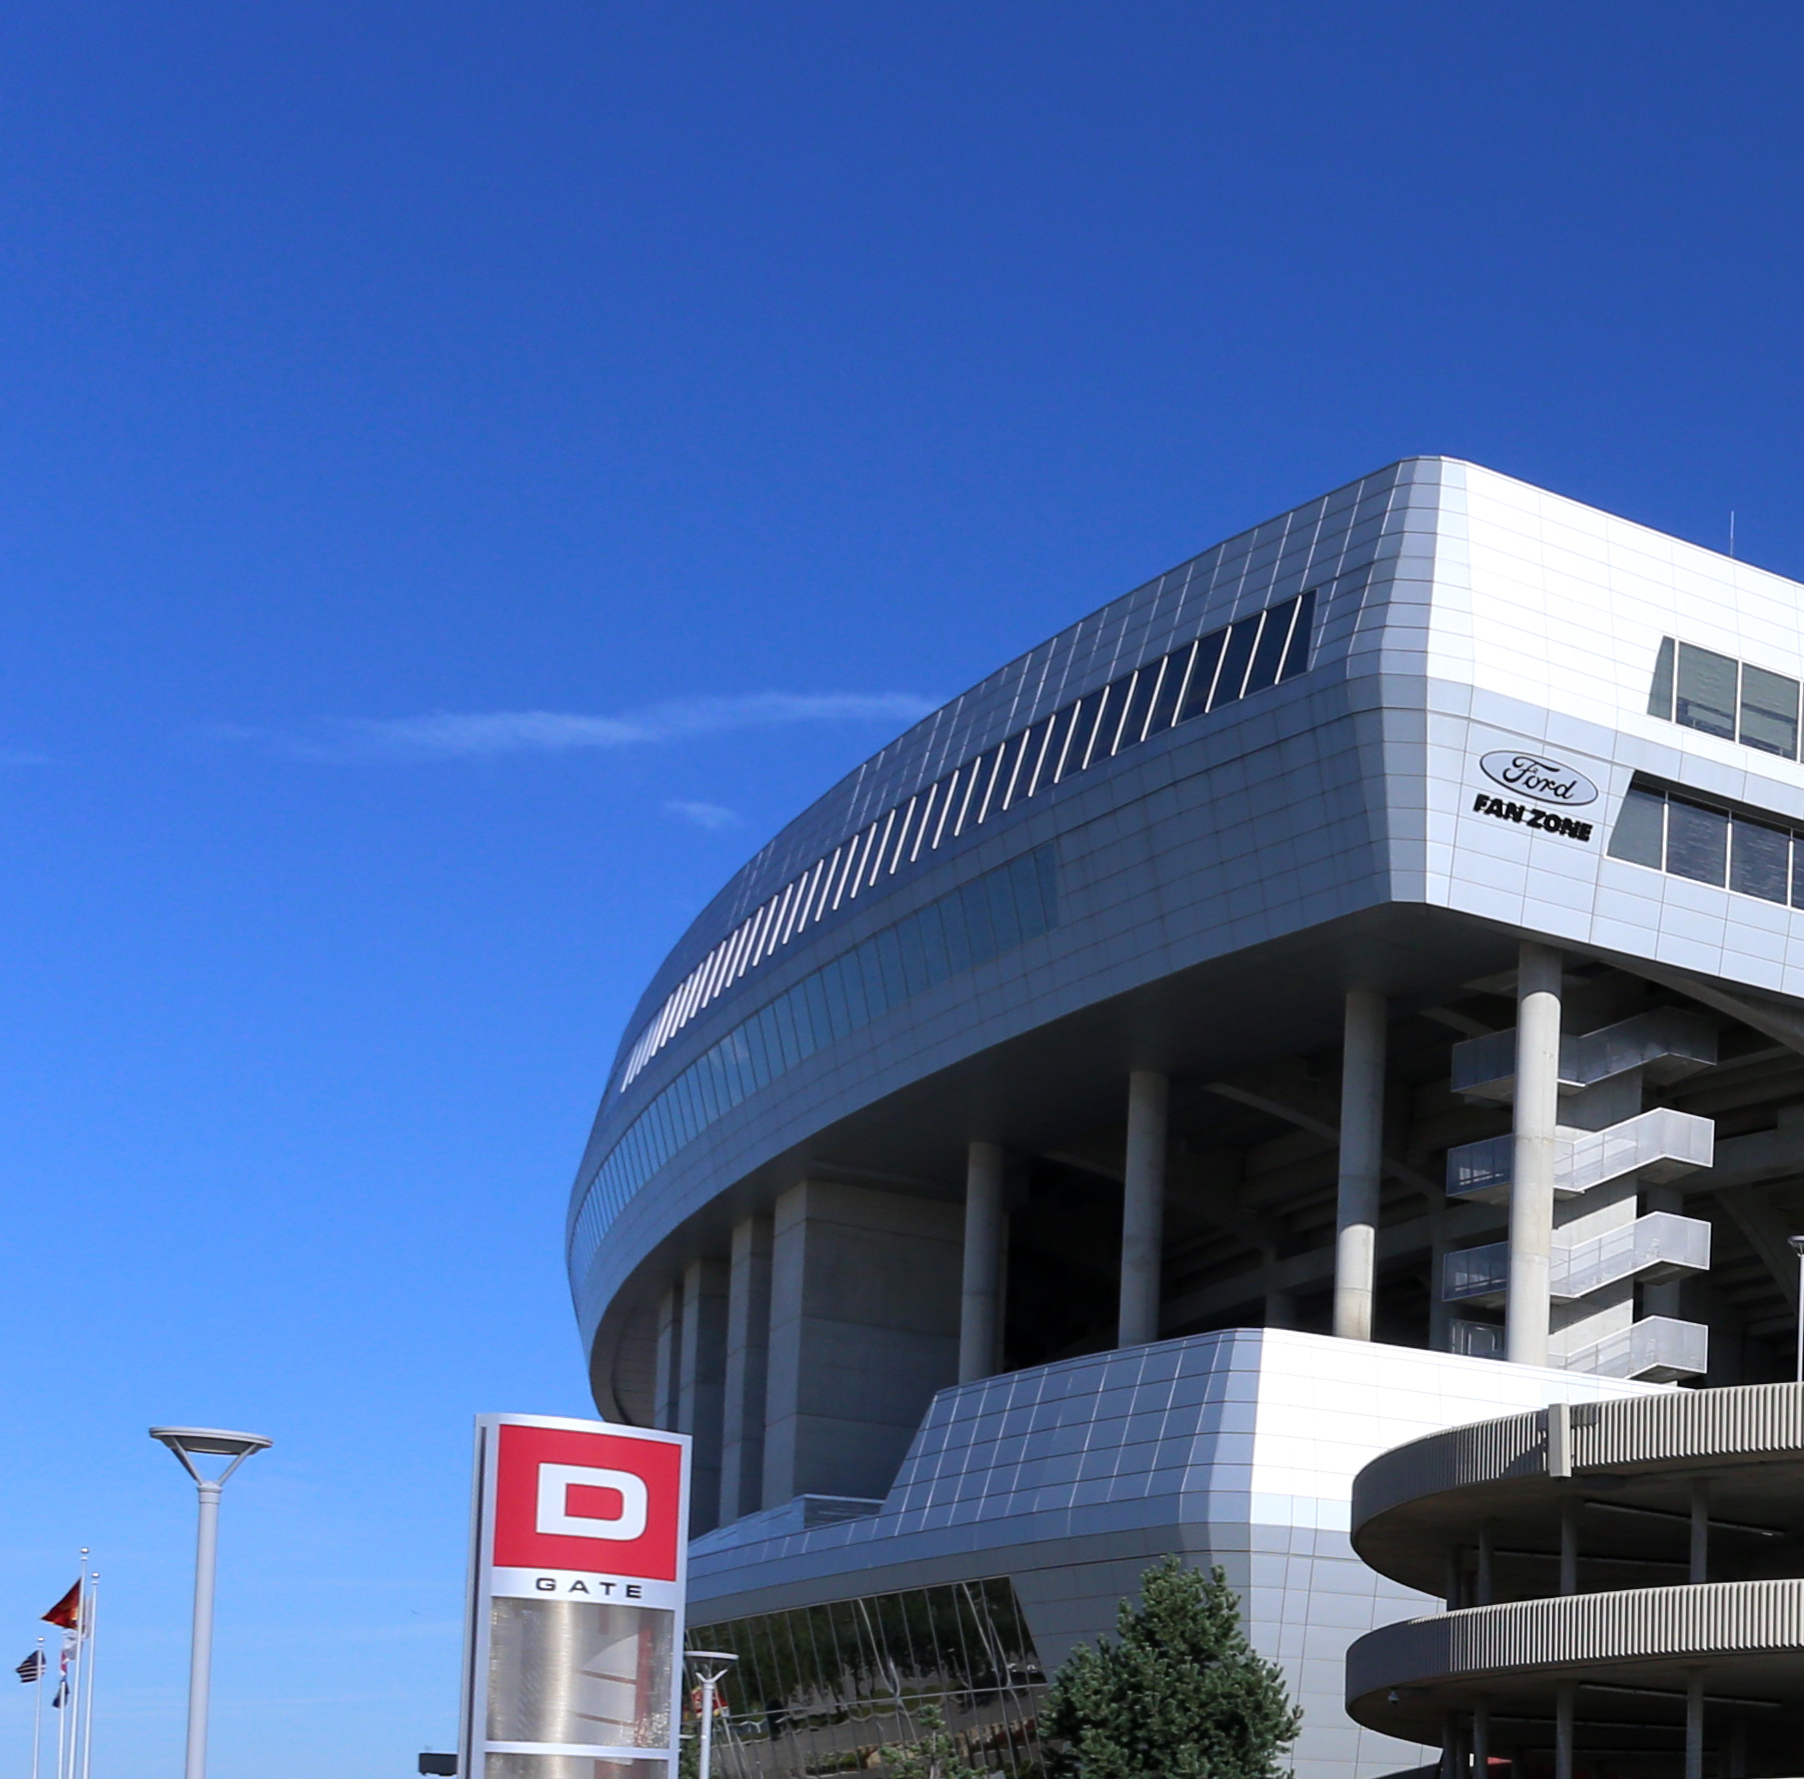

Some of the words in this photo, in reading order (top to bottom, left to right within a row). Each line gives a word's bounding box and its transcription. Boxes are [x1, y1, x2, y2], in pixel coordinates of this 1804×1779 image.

[1503, 757, 1577, 799] Ford
[1473, 793, 1526, 824] FAN
[1526, 808, 1594, 843] ZONE
[536, 1463, 648, 1541] D
[536, 1578, 642, 1599] GATE
